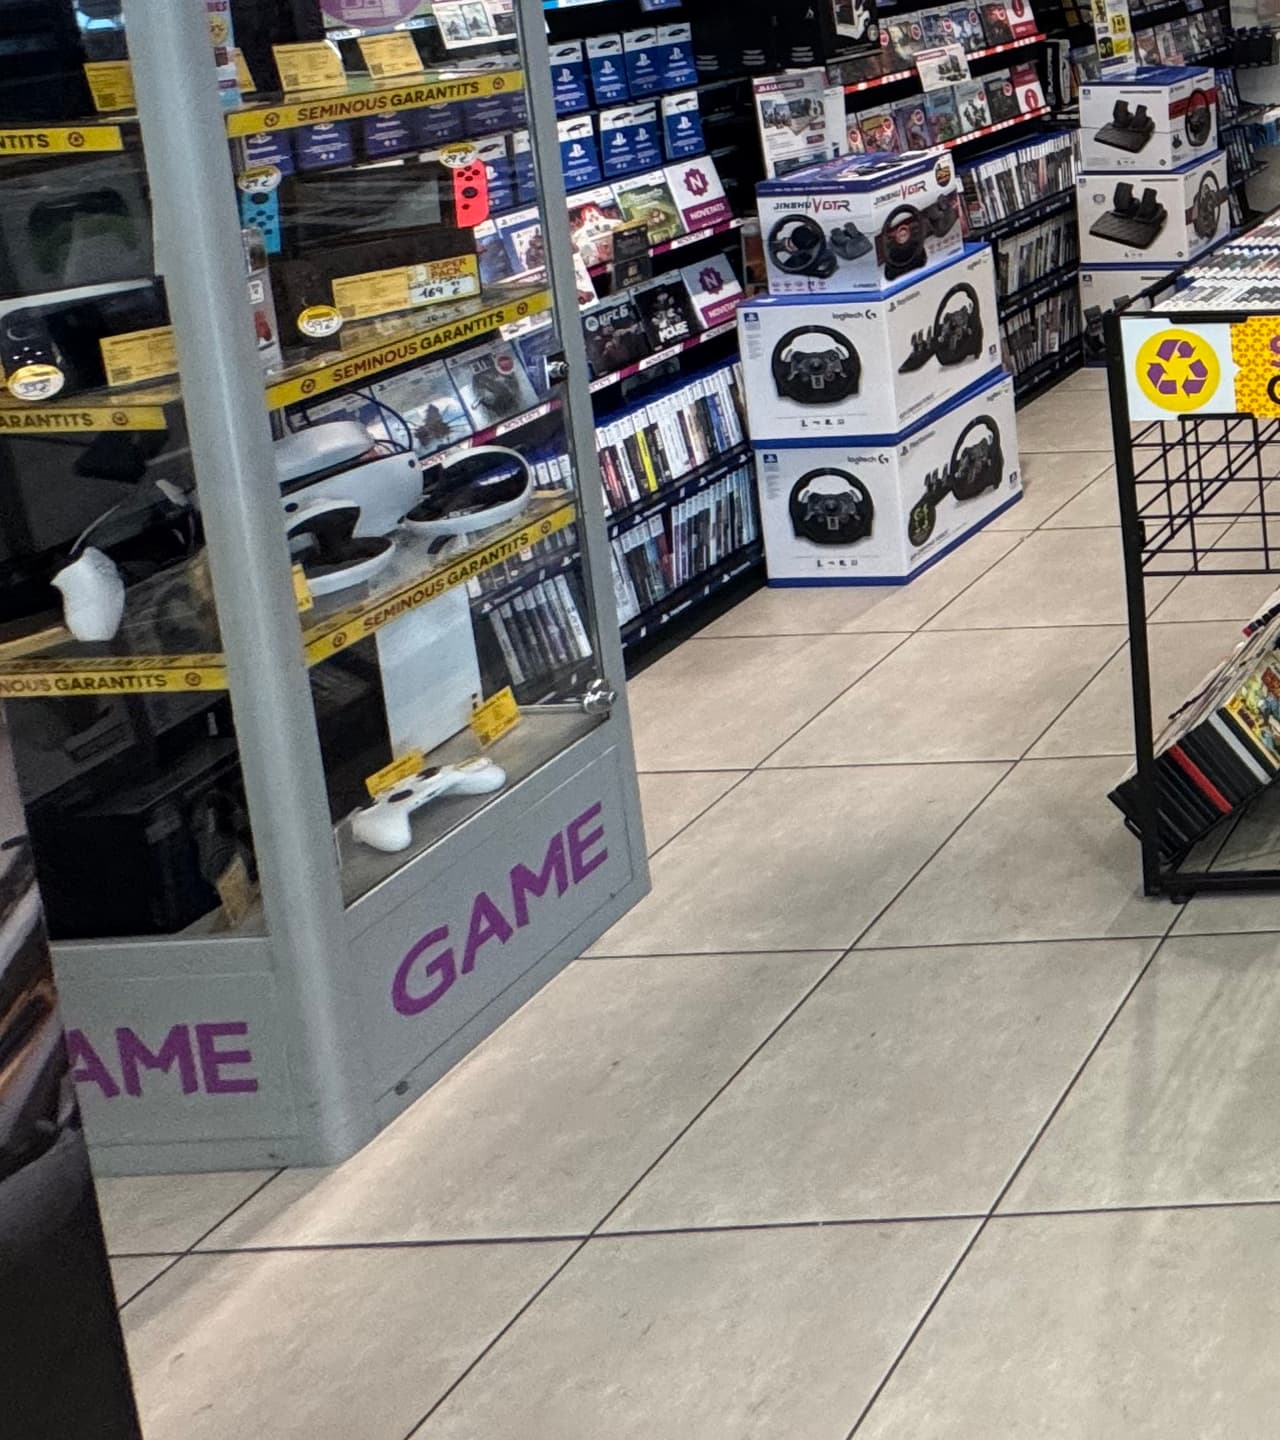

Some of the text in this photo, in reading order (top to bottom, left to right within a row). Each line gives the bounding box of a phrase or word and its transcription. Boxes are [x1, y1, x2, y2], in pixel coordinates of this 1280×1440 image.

[296, 82, 479, 121] SEMINOUS GARANTITS
[332, 311, 505, 383] SEMINOUS GARANTITS
[0, 412, 94, 429] ARANTITS
[364, 532, 530, 632] SEMINOUS GARANTITS
[55, 672, 168, 691] GARANTITS
[390, 800, 609, 1017] GAME
[64, 1022, 258, 1098] AME
